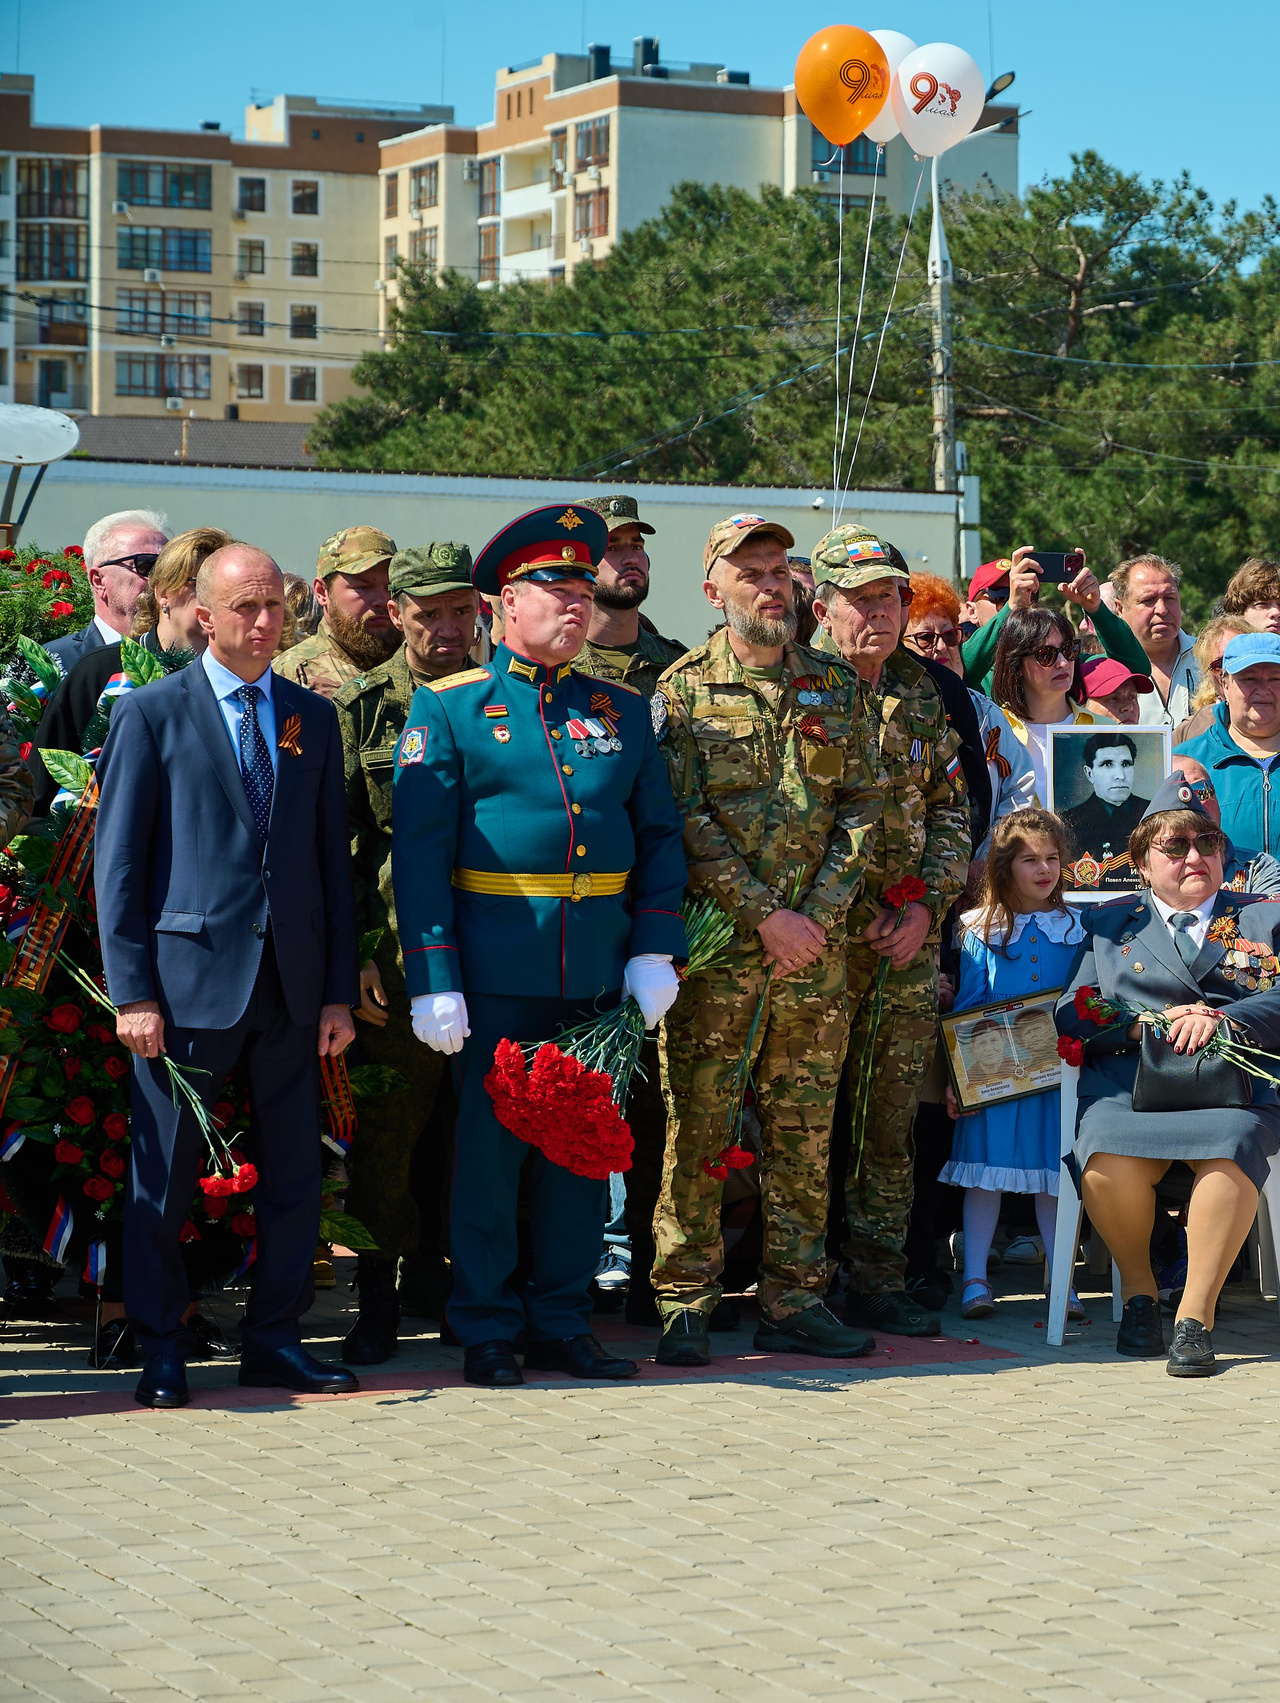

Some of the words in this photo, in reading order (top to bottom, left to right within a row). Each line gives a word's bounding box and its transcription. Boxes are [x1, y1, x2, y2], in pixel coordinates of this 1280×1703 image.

[840, 59, 870, 105] 9
[910, 72, 938, 115] 9
[845, 535, 877, 545] РОССИЯ
